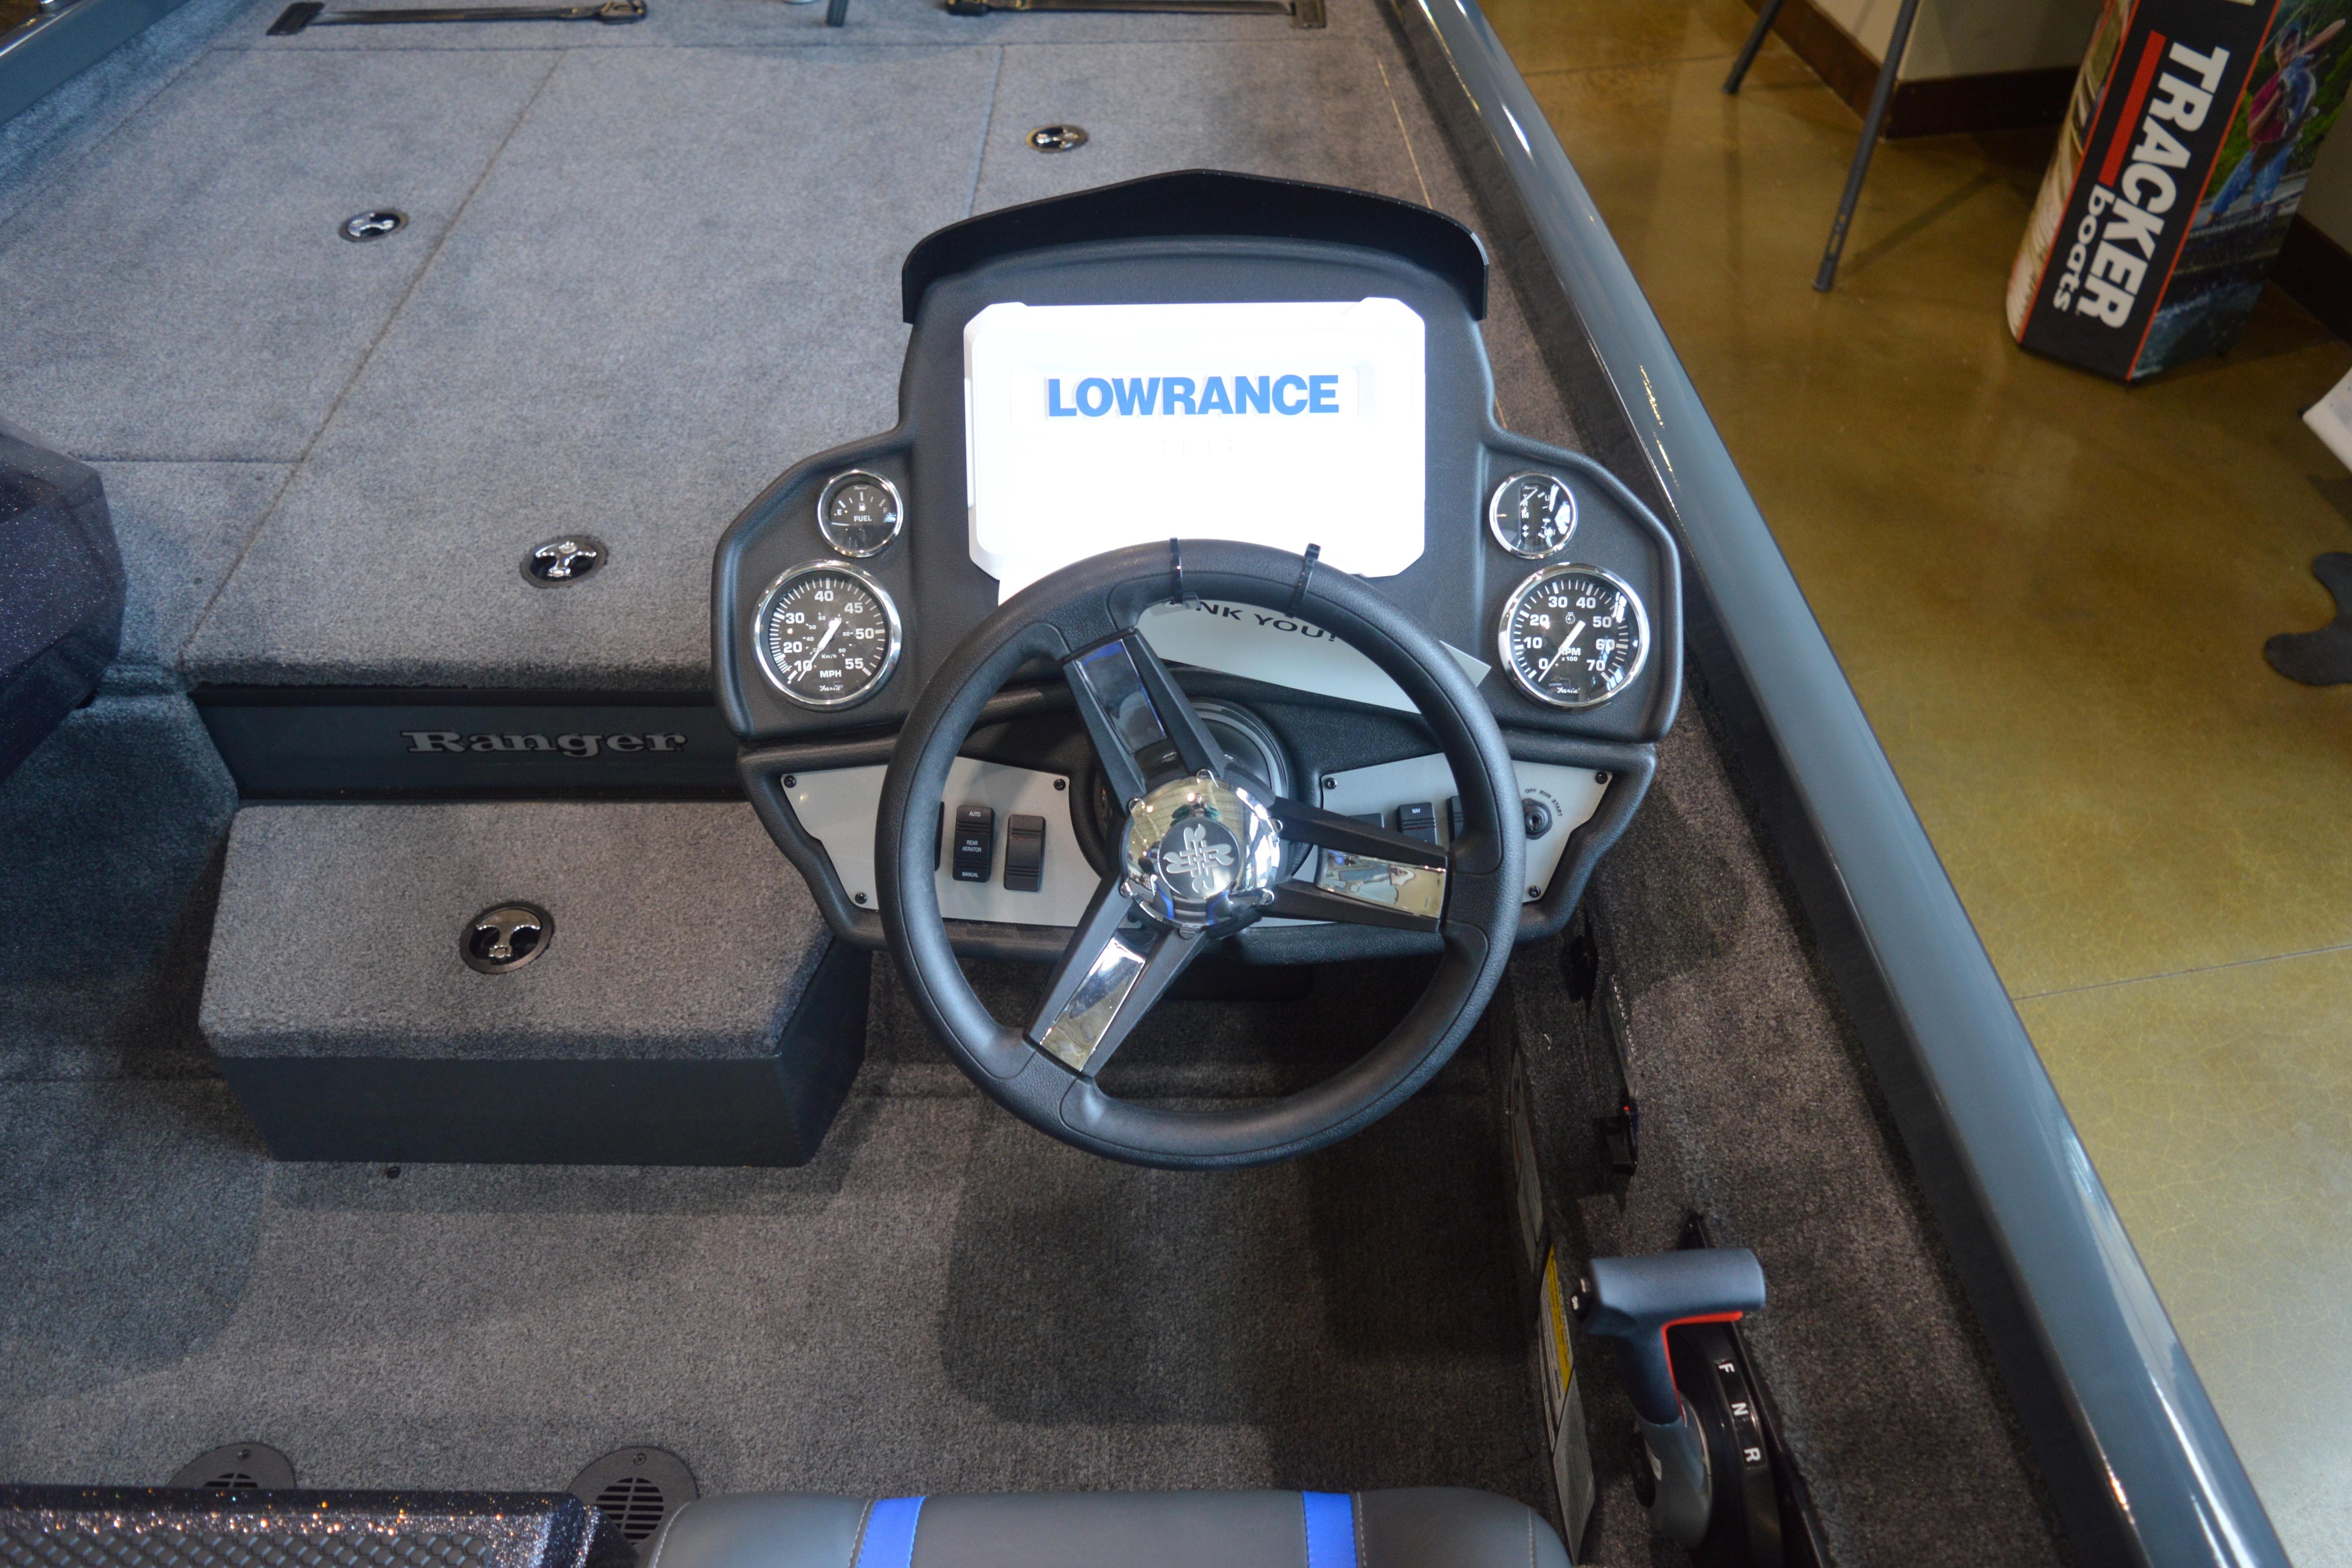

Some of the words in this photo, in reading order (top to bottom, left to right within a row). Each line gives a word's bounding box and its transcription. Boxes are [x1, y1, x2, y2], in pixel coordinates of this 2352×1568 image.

[2076, 41, 2230, 329] TRACKER
[2053, 184, 2116, 312] boats
[1047, 374, 1339, 417] LOWRANCE
[814, 590, 834, 602] 40
[1548, 596, 1568, 608] 30
[844, 602, 863, 614] 45
[1576, 597, 1596, 608] 40
[785, 612, 805, 624] 30
[1530, 614, 1549, 626] 20
[1593, 616, 1612, 628] 50
[855, 628, 874, 640] 50
[784, 641, 802, 653] 20
[1523, 637, 1542, 649] 10
[1596, 639, 1615, 650] 60
[794, 660, 812, 671] 10
[845, 658, 864, 670] 55
[1538, 658, 1548, 670] 0
[1586, 659, 1606, 671] 70
[820, 670, 842, 678] MPH
[401, 731, 687, 758] Ranger
[1540, 790, 1552, 799] RUN
[1552, 799, 1562, 817] START
[1718, 1363, 1735, 1373] F
[1731, 1402, 1749, 1416] N
[1744, 1447, 1761, 1462] R
